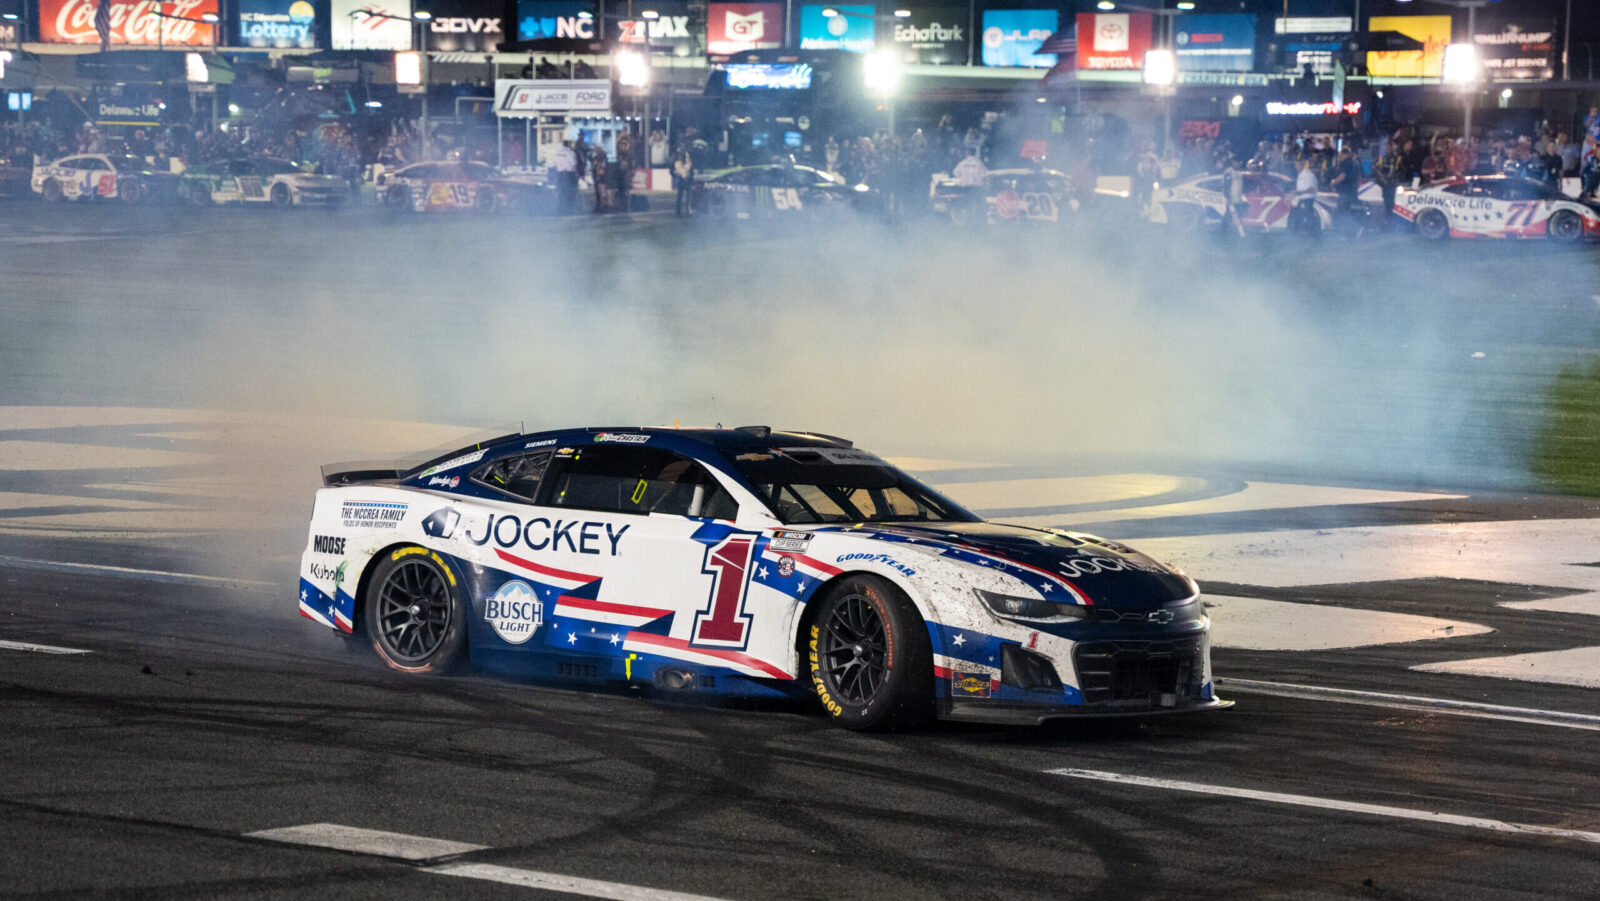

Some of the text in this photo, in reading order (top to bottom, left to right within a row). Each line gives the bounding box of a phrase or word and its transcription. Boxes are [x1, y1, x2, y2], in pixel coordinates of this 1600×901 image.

[241, 21, 308, 42] Lottery
[557, 16, 594, 39] NC
[894, 22, 963, 42] EchoPark
[1087, 56, 1134, 68] TOYOTA
[772, 187, 802, 211] 54
[1260, 196, 1281, 222] 7
[1469, 196, 1493, 210] Life
[1506, 201, 1541, 226] 71
[524, 438, 558, 449] SIEMENS
[341, 507, 406, 522] THE MCCREA FAMILY
[313, 534, 346, 555] MOOSE
[465, 513, 631, 556] JOCKEY
[836, 552, 916, 577] GOODYEAR
[692, 533, 759, 648] 1
[486, 600, 543, 625] BUSCH
[499, 621, 531, 633] LIGHT
[1027, 631, 1039, 648] 1
[809, 624, 842, 717] GOODYEAR
